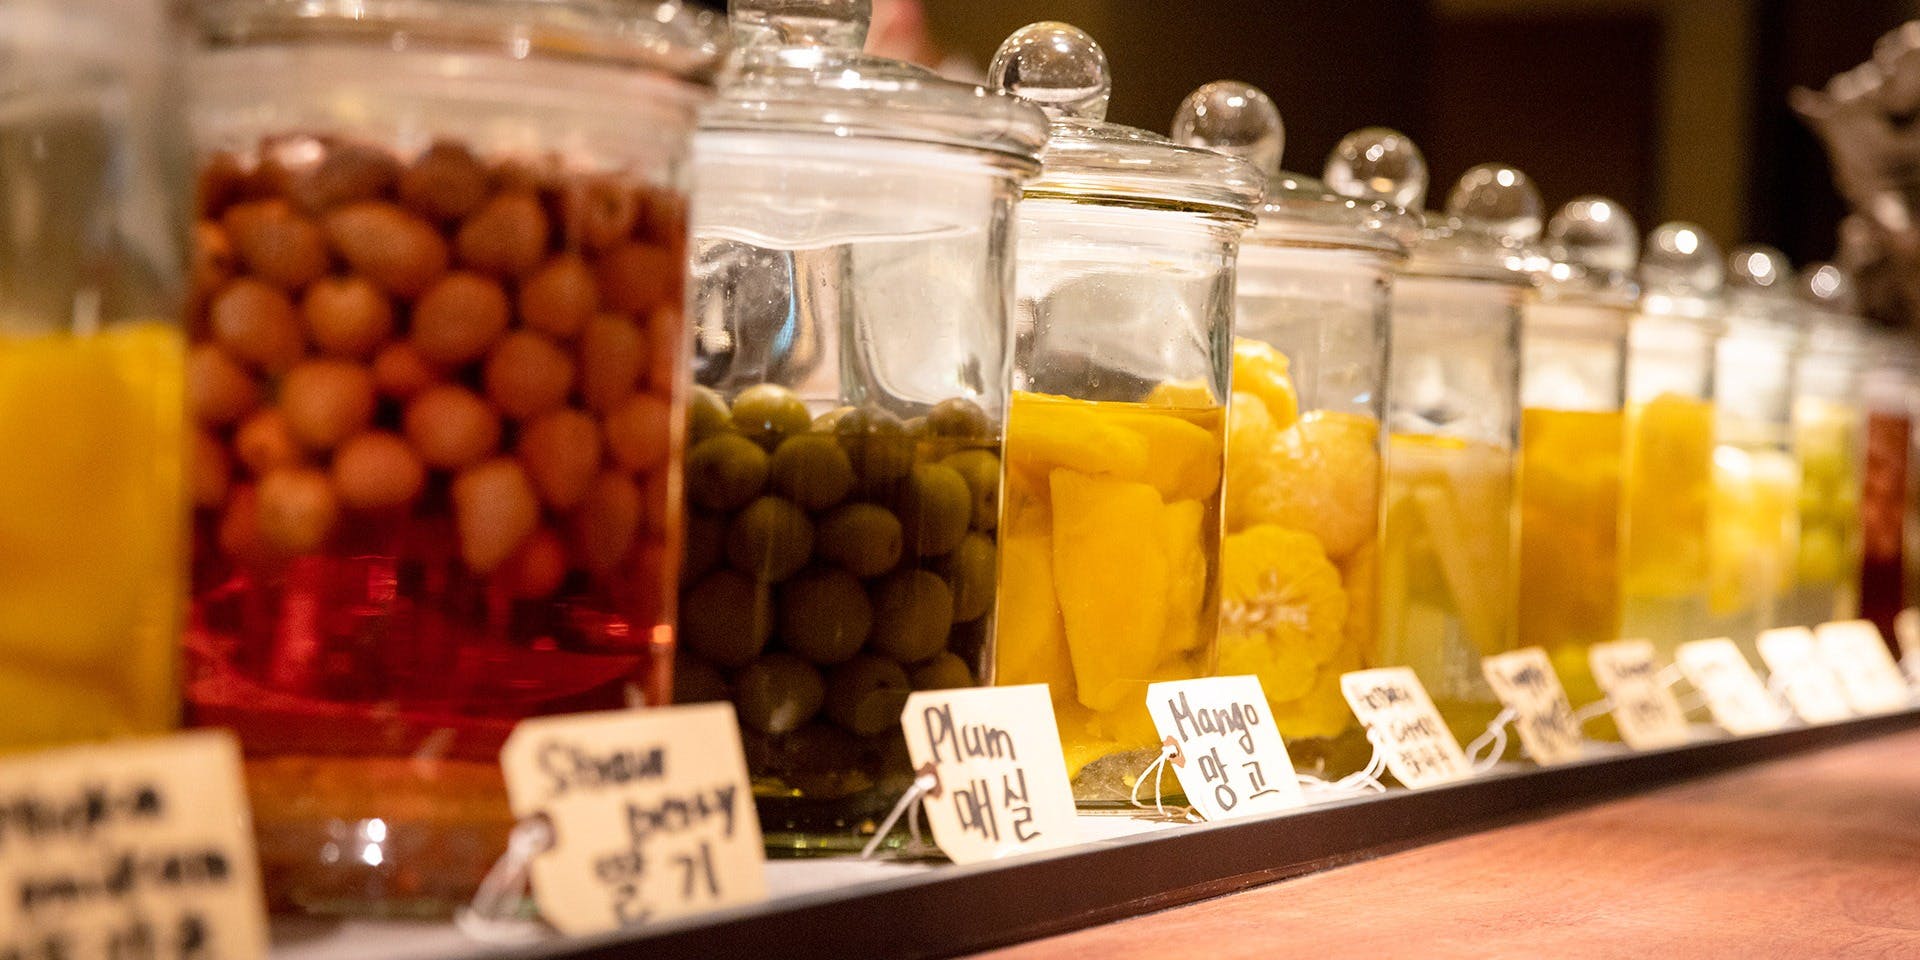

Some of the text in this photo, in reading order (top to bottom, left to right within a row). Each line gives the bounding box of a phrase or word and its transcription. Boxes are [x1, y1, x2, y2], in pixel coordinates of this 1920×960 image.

[923, 703, 1018, 766] Plum
[1168, 691, 1259, 755] Mango
[953, 768, 1041, 843] 매실
[1198, 747, 1280, 812] 망고
